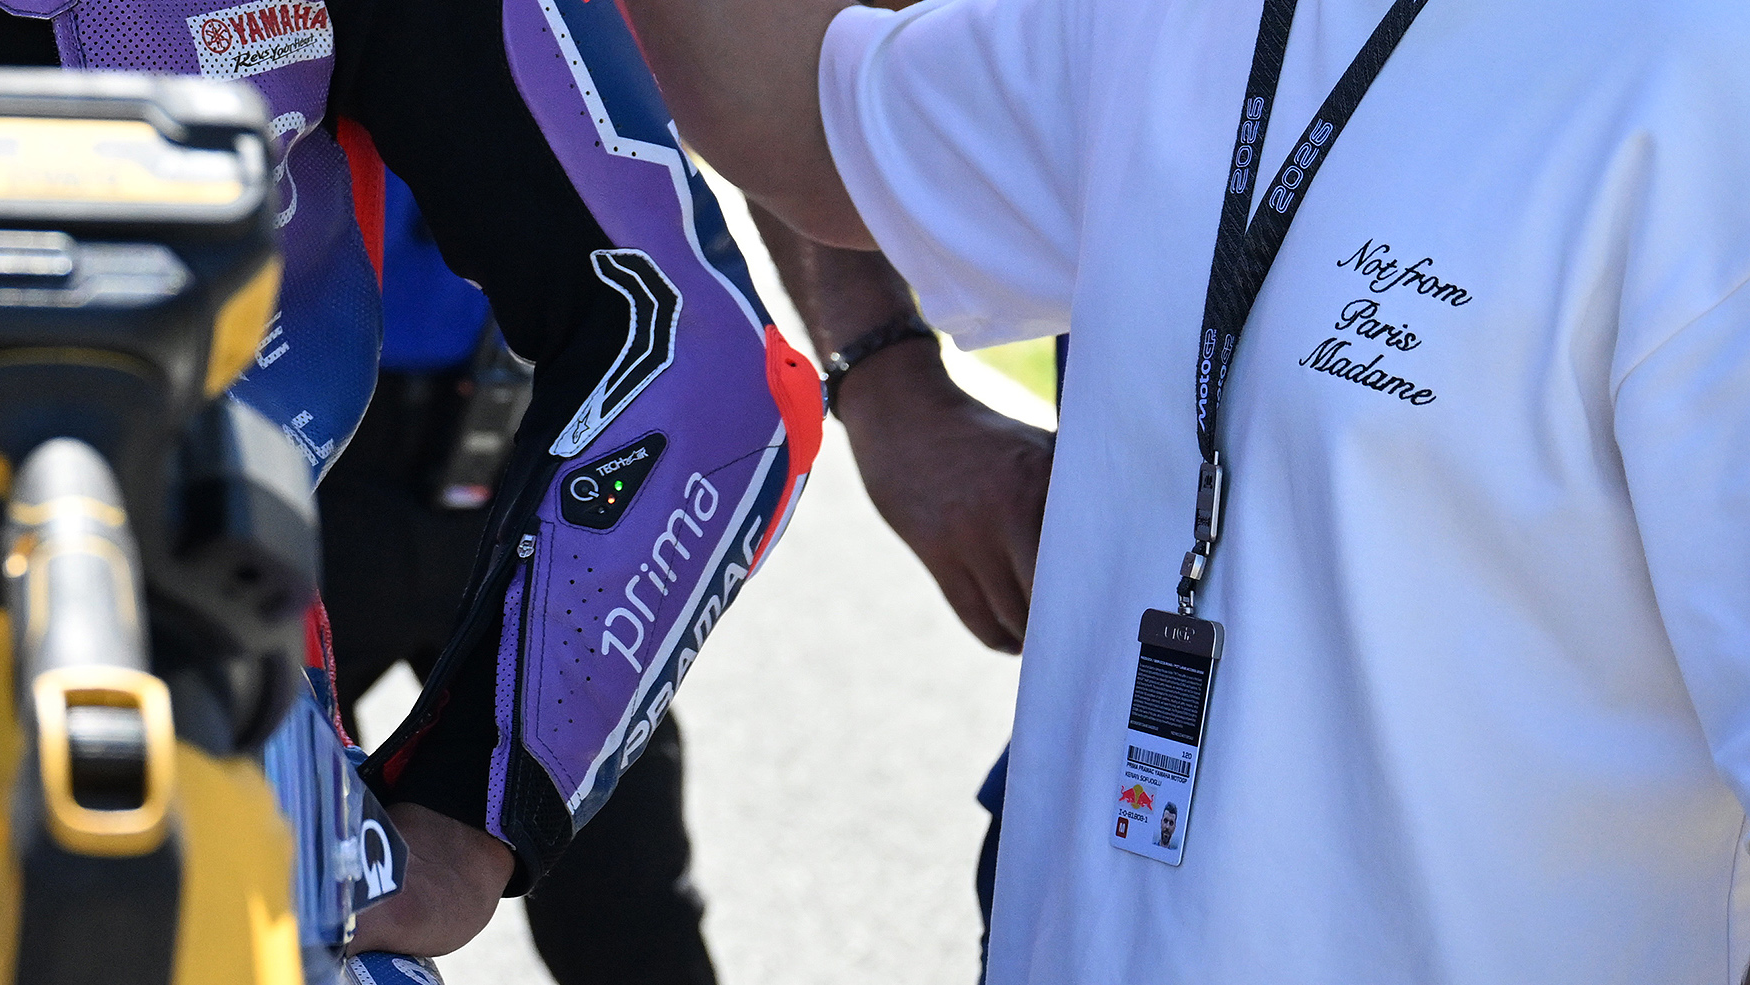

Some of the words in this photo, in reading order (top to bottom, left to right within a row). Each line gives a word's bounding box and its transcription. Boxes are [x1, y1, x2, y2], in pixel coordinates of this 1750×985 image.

[228, 4, 327, 46] YAMAHA
[1230, 97, 1265, 194] 2026
[1269, 118, 1334, 214] 2026
[1337, 238, 1398, 281] Not
[1369, 257, 1473, 307] from
[1335, 299, 1422, 352] Paris
[1299, 337, 1437, 406] Madame
[601, 472, 719, 673] prima
